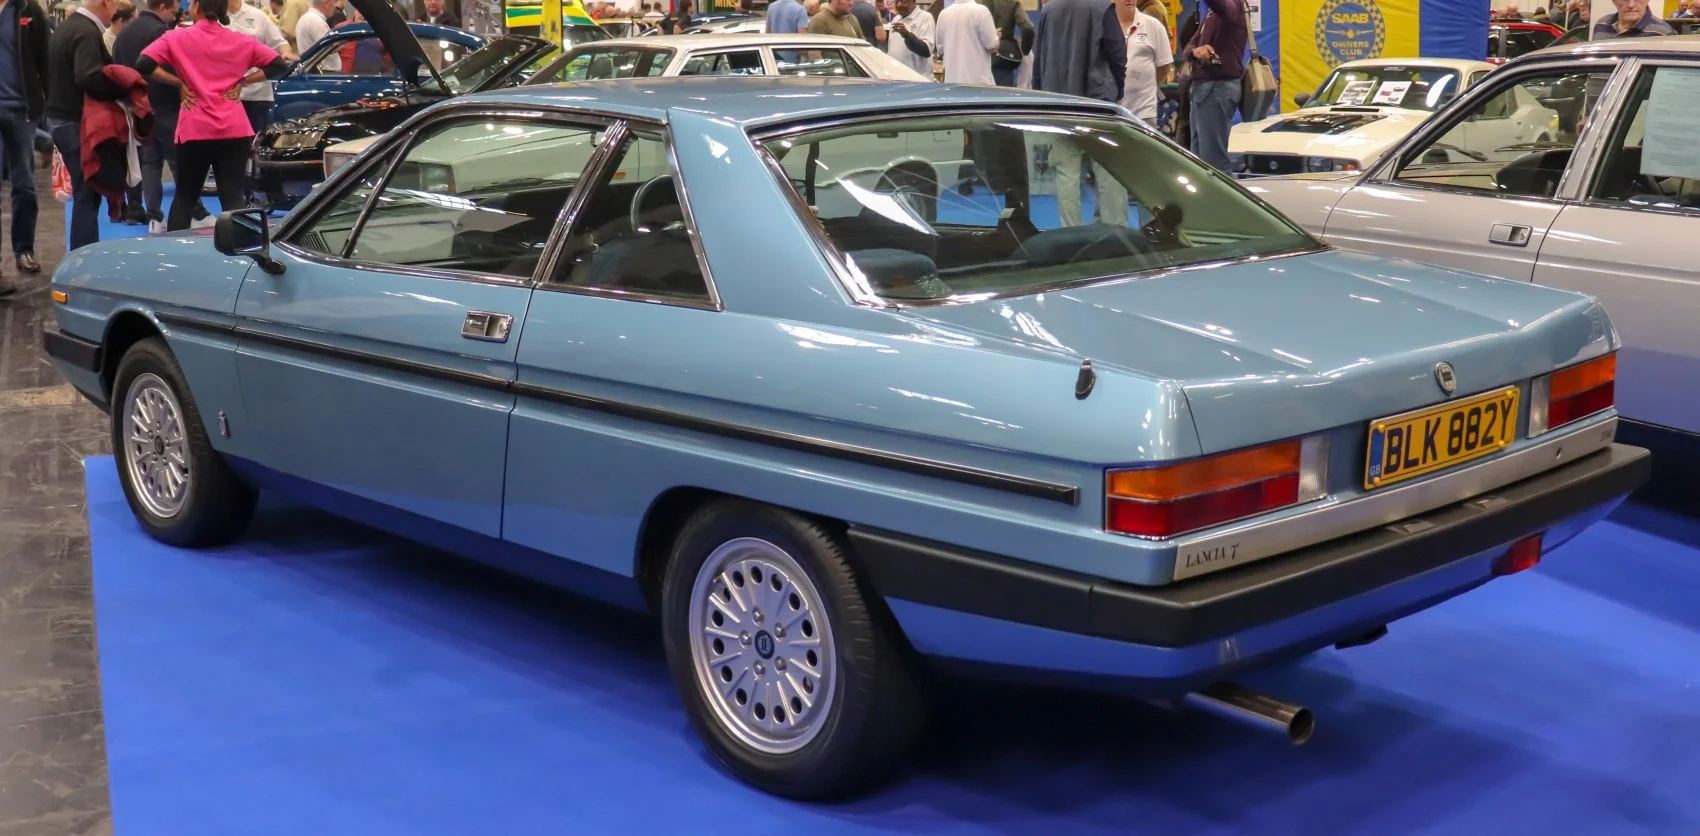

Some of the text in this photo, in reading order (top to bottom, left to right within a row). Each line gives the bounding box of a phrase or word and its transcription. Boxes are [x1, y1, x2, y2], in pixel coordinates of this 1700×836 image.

[1331, 13, 1369, 24] SAAB
[1340, 48, 1363, 56] CLUB
[1383, 398, 1514, 475] BLK 882Y
[1369, 464, 1381, 476] GB
[1186, 546, 1225, 568] LANCIA
